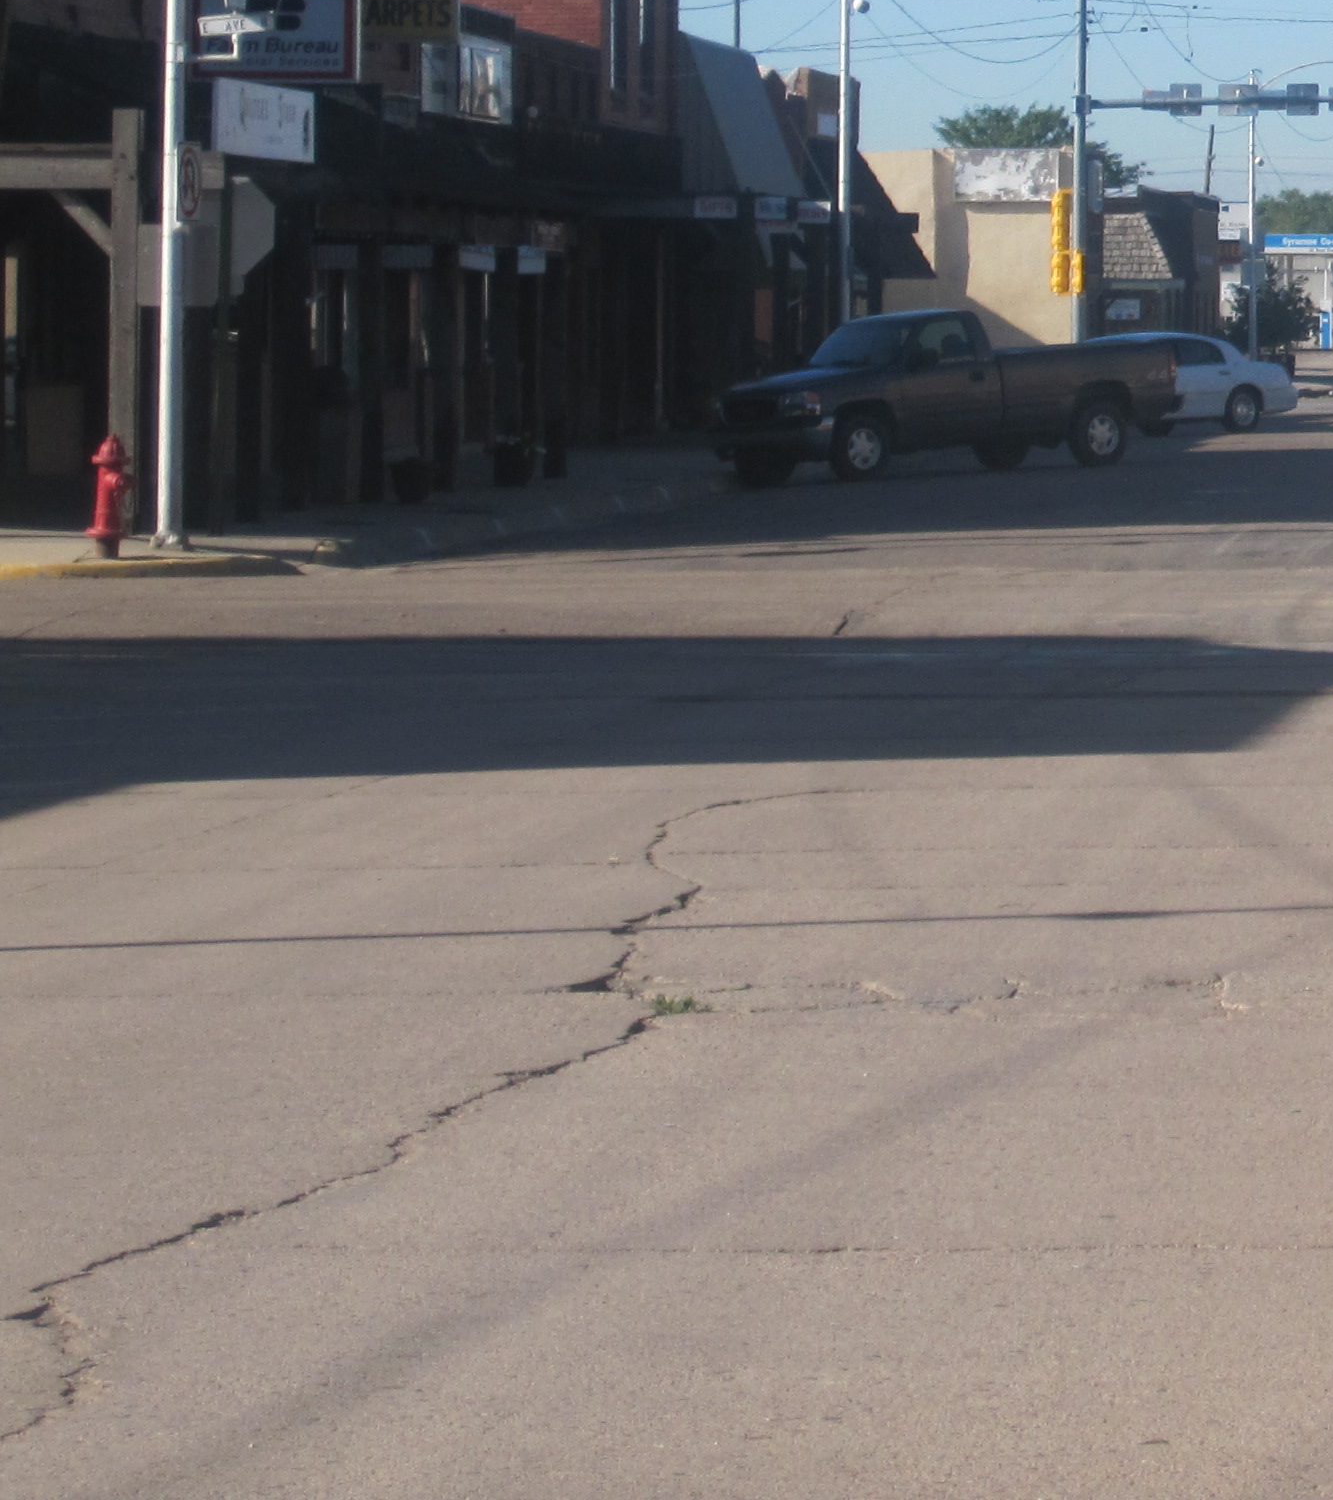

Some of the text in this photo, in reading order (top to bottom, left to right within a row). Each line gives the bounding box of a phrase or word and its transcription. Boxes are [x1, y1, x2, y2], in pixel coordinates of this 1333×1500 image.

[364, 0, 451, 26] ARPETS
[202, 21, 208, 34] E
[225, 19, 246, 32] AVE
[206, 37, 339, 53] Fam Bureau
[279, 56, 339, 67] Services
